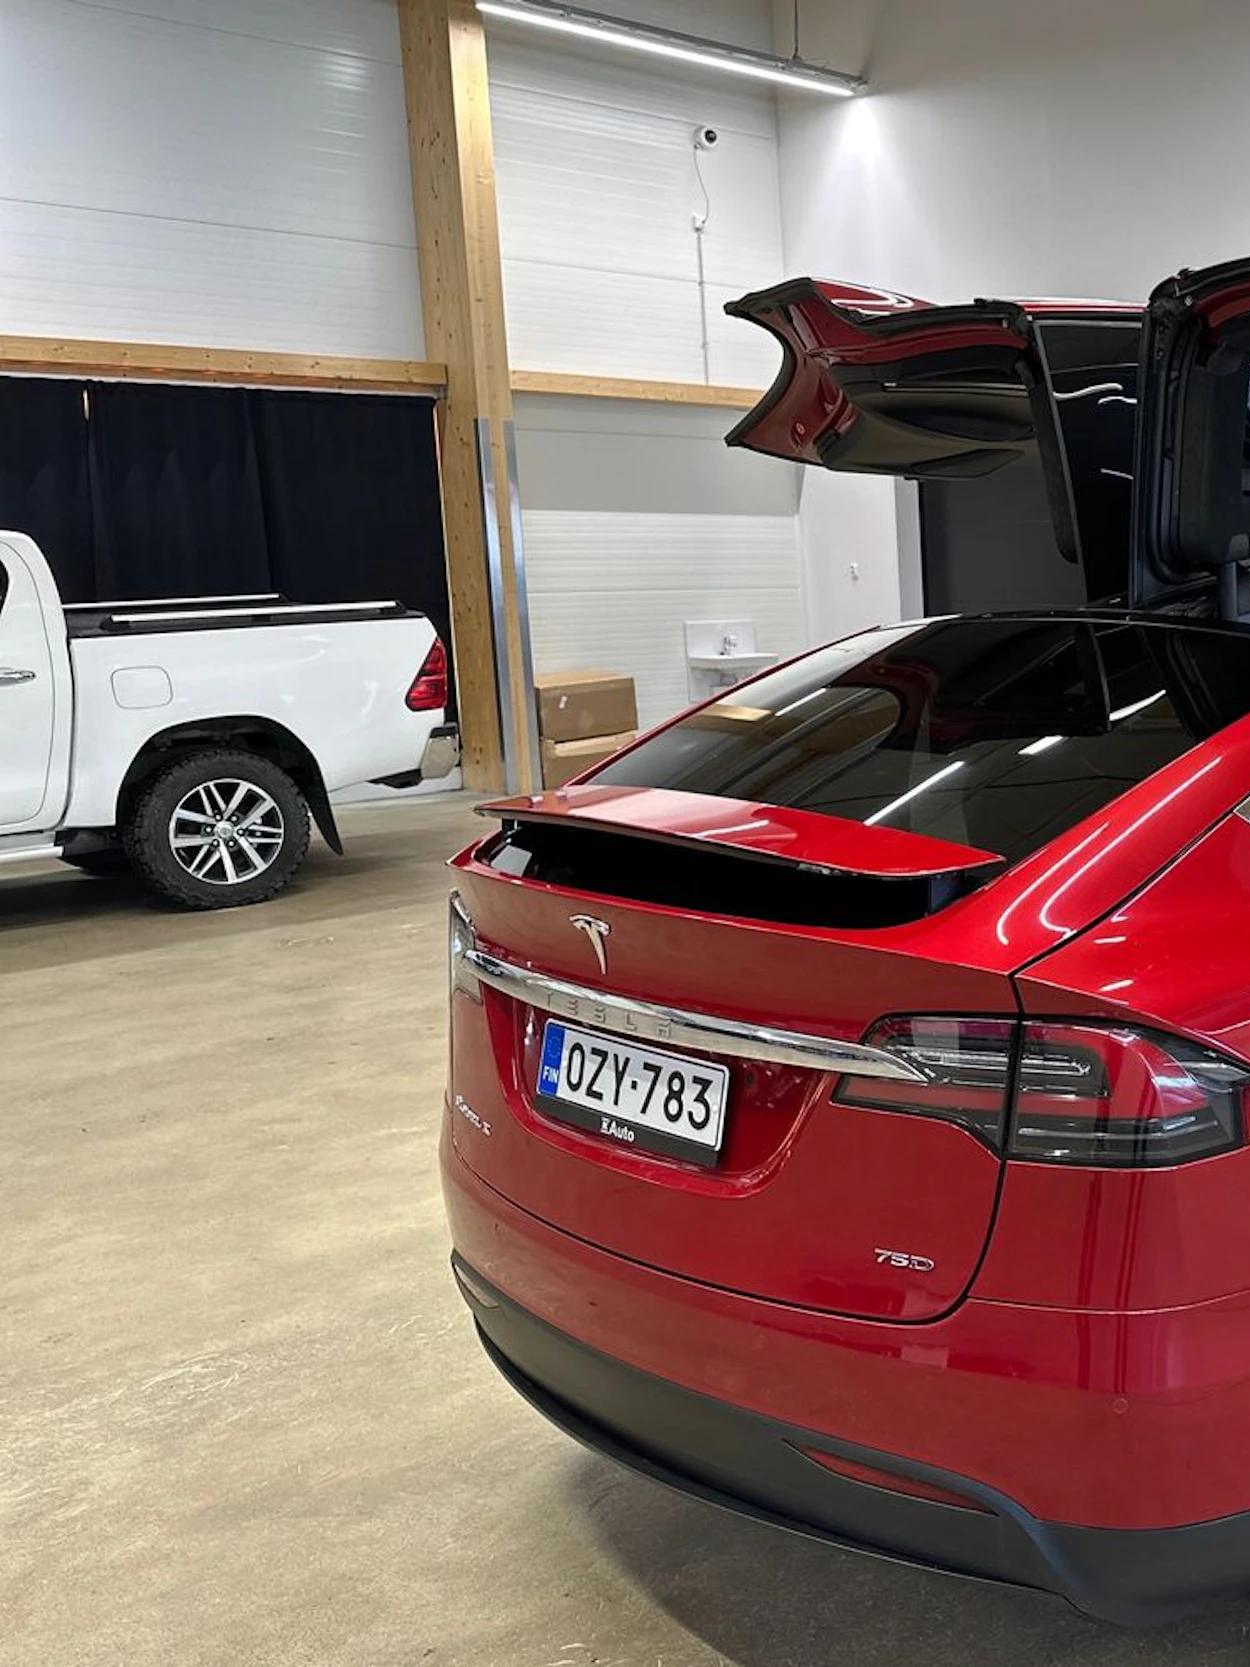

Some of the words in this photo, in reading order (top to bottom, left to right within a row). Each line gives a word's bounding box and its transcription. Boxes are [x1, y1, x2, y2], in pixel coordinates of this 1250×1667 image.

[544, 990, 672, 1037] TESLA
[542, 1065, 559, 1084] FIN
[566, 1042, 714, 1130] OZY-783
[874, 1247, 935, 1272] 75D
